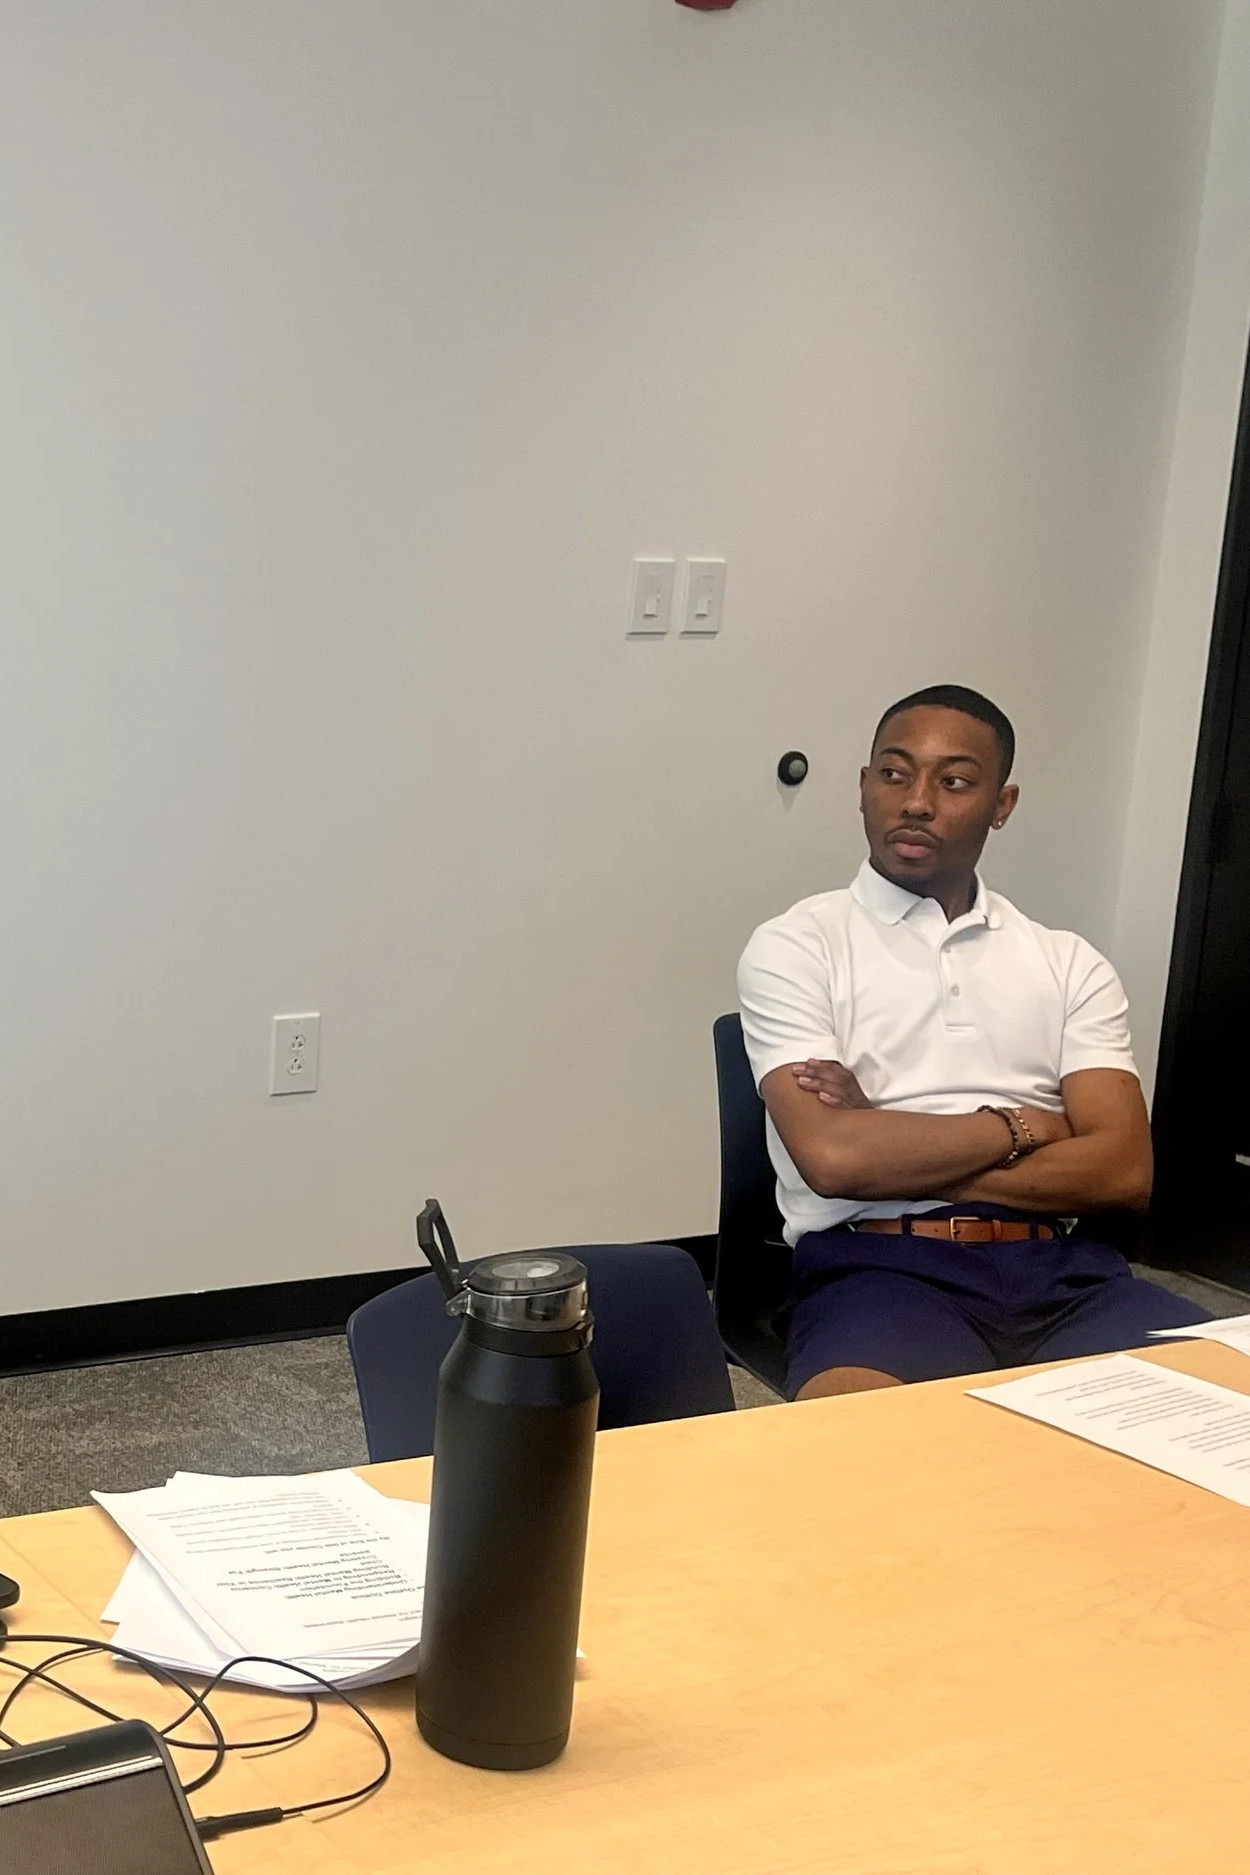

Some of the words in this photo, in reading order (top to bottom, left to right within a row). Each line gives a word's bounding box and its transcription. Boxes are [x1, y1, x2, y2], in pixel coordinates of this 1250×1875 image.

[353, 1564, 389, 1572] Building
[343, 1570, 395, 1579] Responding
[364, 1574, 401, 1582] Building
[300, 1583, 348, 1591] Foundation
[344, 1580, 408, 1591] Understanding
